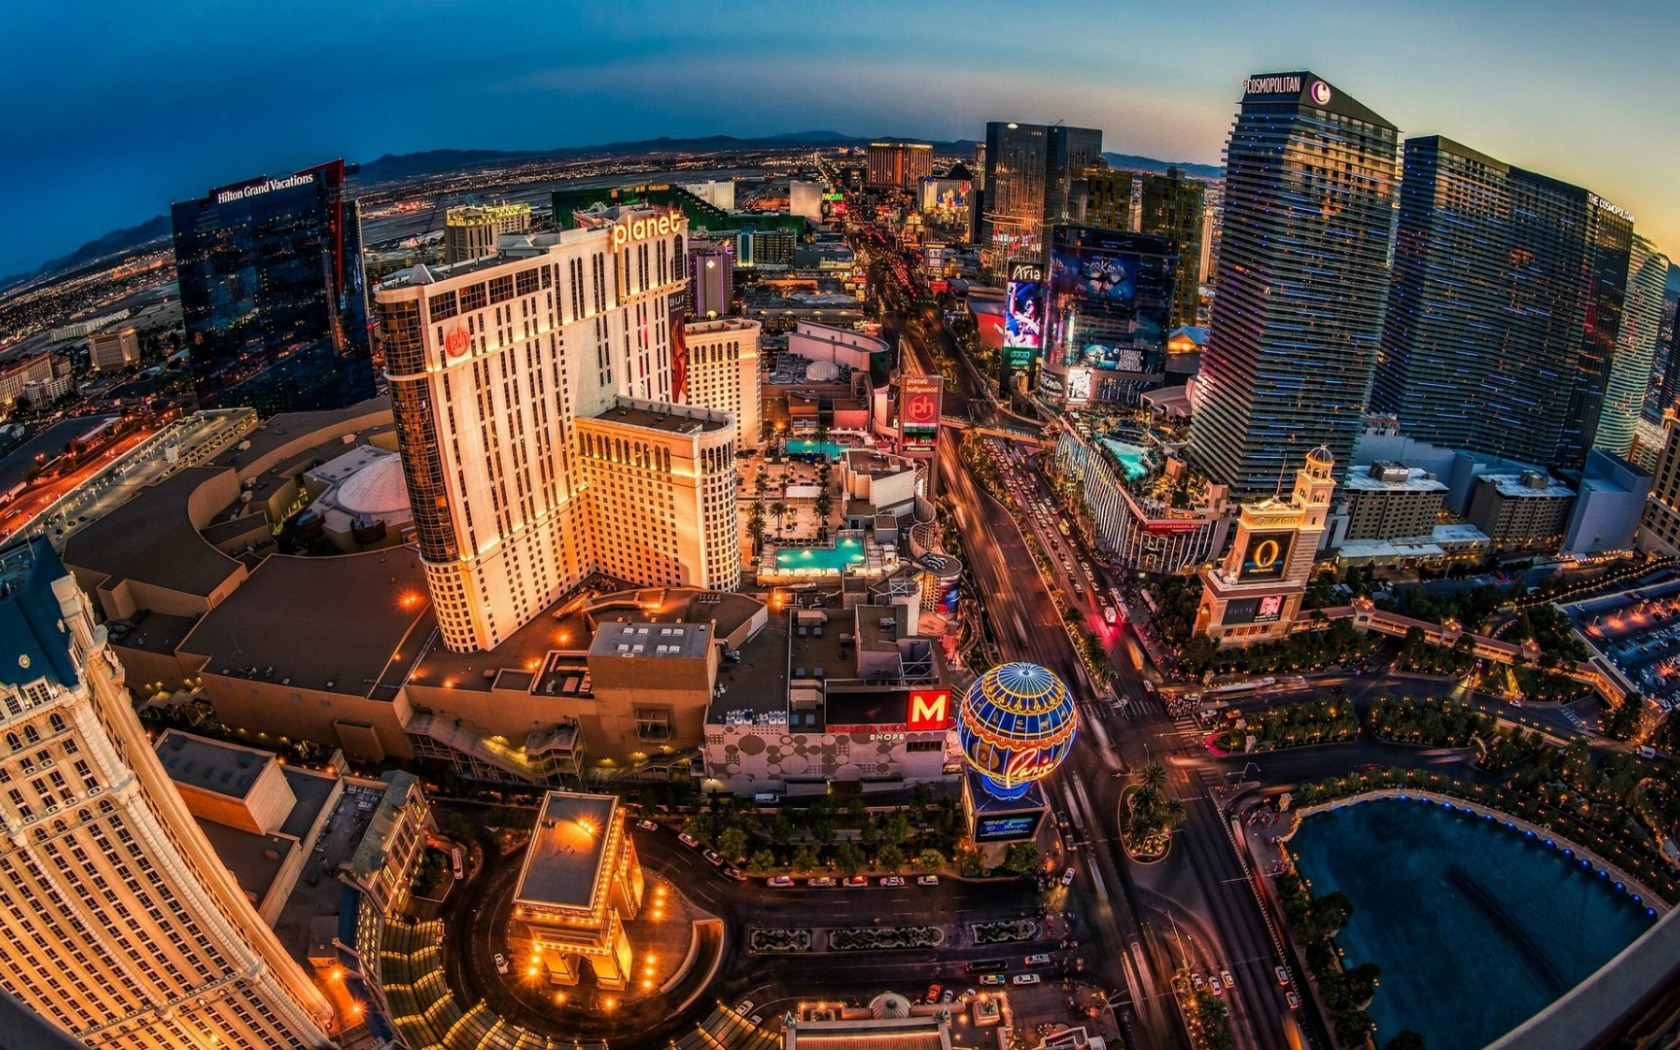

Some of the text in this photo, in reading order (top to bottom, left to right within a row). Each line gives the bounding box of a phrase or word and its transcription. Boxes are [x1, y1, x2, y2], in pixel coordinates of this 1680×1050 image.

[1247, 76, 1301, 94] COSMOPOLITAN
[217, 174, 314, 204] Hilton Grand Vacations
[822, 193, 844, 201] MGM
[1588, 192, 1635, 224] THE COSMOPOLITAN
[613, 210, 680, 253] planet
[1012, 265, 1041, 280] Aria
[912, 396, 934, 417] ph
[1253, 540, 1279, 568] O
[911, 695, 946, 722] M
[826, 725, 876, 733] MIRACLE
[869, 733, 905, 741] SHOPS
[1006, 748, 1054, 789] Paris
